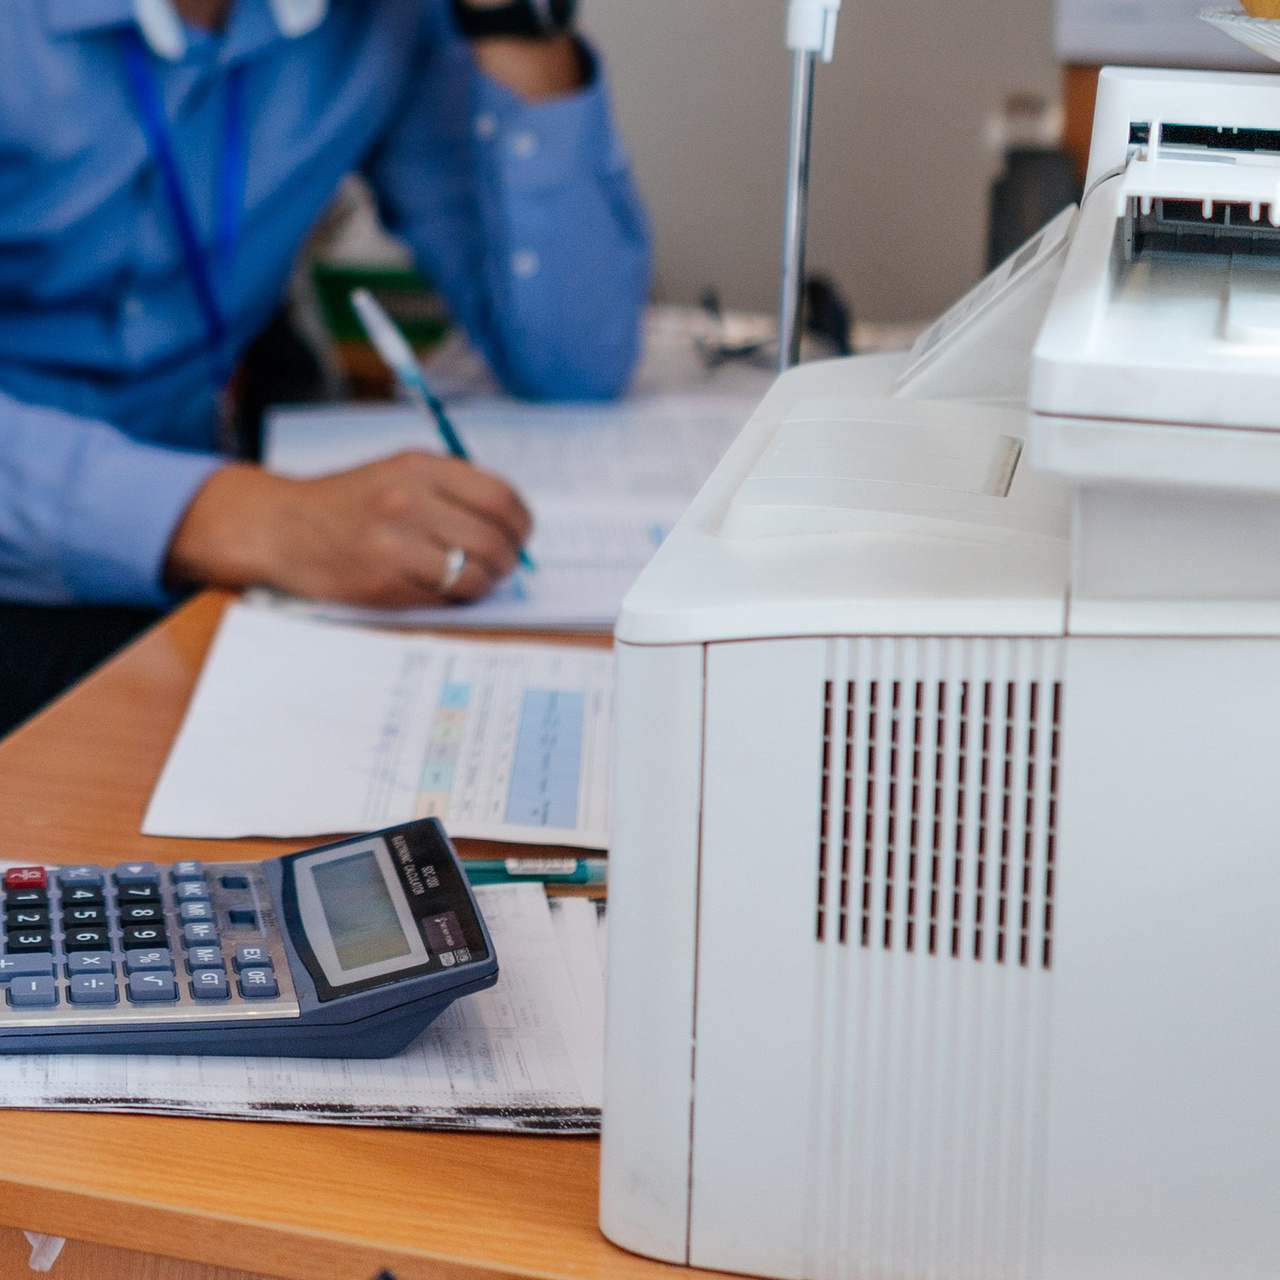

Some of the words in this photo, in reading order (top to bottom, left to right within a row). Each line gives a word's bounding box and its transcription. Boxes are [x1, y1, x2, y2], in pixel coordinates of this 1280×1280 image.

[403, 863, 426, 896] CALCULATOR
[72, 890, 93, 899] 4
[128, 888, 150, 896] 7
[74, 910, 96, 919] 5
[131, 909, 153, 917] 8
[187, 904, 206, 917] MR
[17, 914, 39, 923] 2
[133, 930, 155, 939] 9
[191, 924, 210, 938] M-
[19, 935, 41, 944] 3
[76, 932, 98, 941] 6
[138, 952, 160, 964] %
[196, 948, 214, 961] M+
[242, 948, 261, 960] EX
[201, 972, 218, 985] GT
[247, 970, 266, 984] OFF
